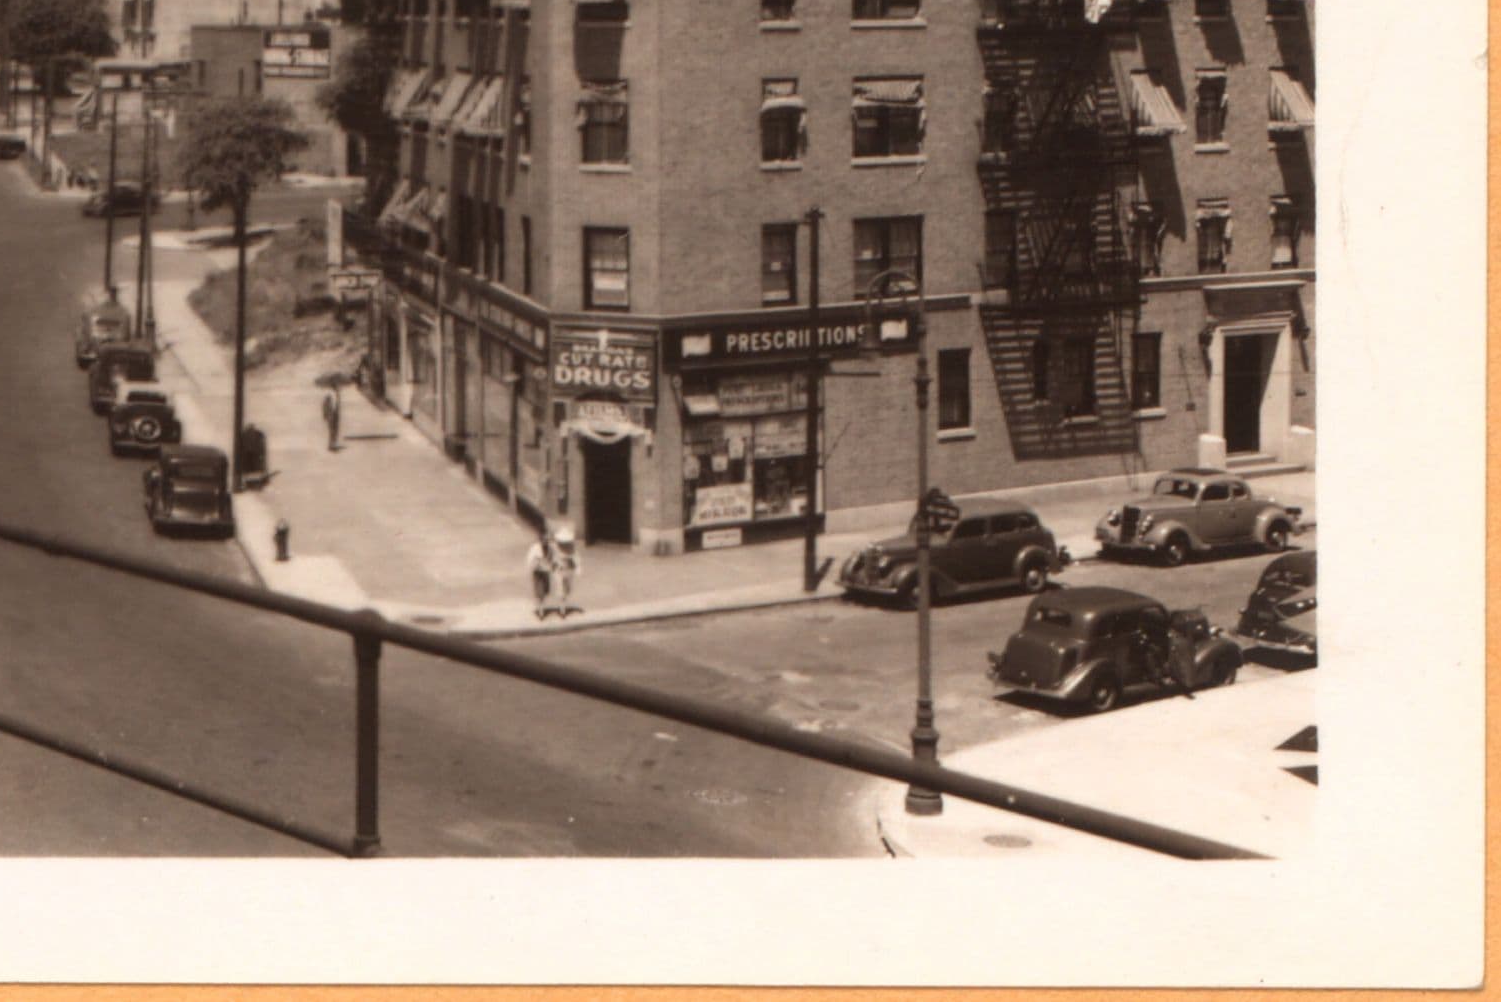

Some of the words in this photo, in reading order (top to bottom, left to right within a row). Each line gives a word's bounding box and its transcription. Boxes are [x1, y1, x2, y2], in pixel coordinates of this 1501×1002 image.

[560, 352, 594, 366] CUT
[598, 353, 648, 369] RATE
[554, 365, 651, 389] DRUGS
